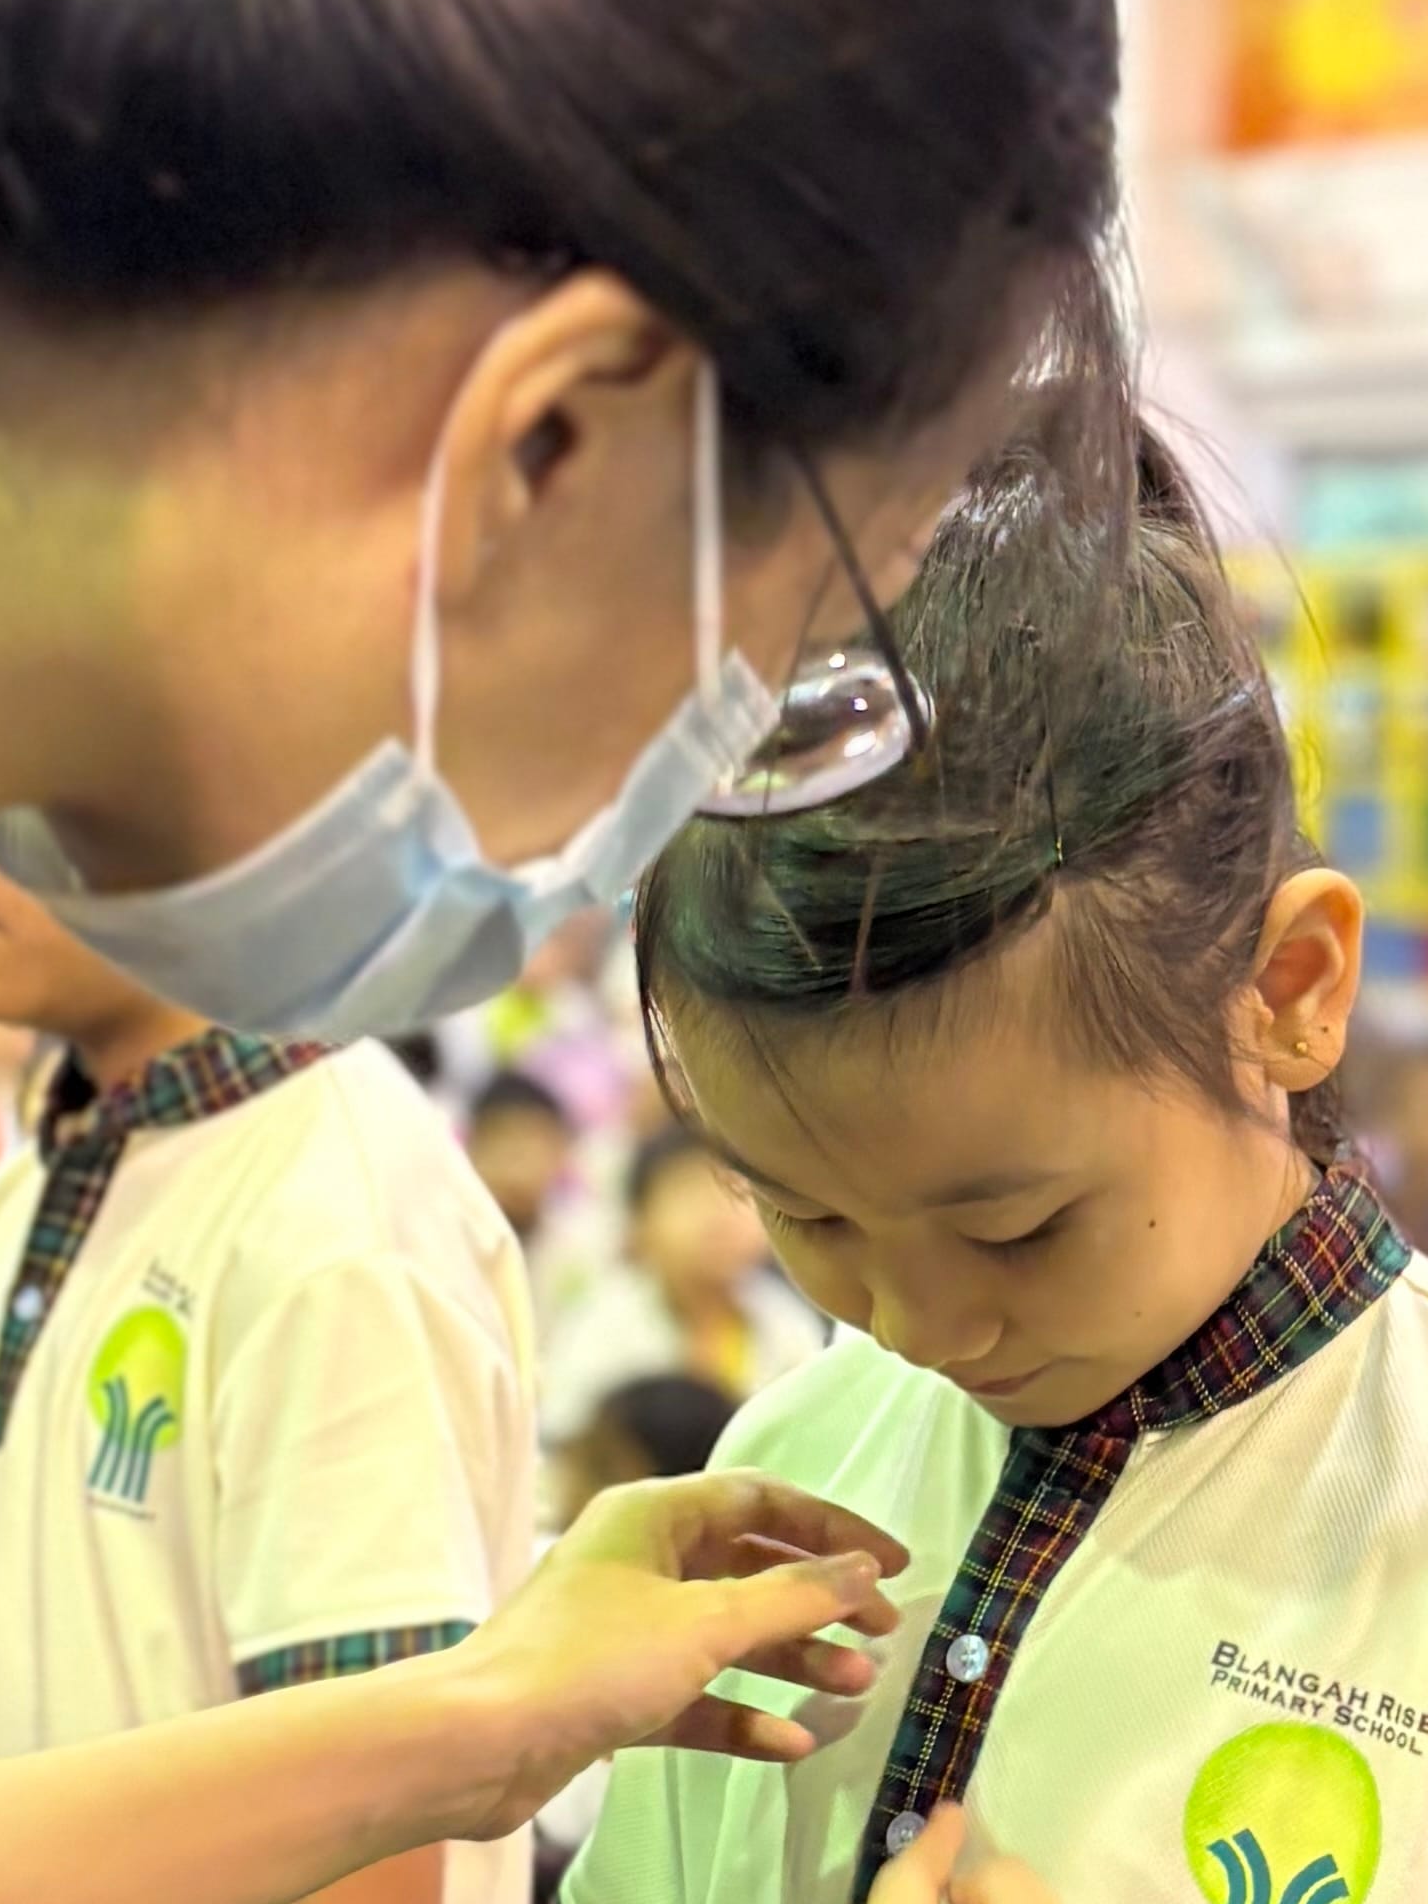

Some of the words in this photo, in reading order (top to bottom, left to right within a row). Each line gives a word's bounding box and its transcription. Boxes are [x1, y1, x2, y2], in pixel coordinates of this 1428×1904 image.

[1210, 1669, 1325, 1718] PRIMARY
[1333, 1705, 1423, 1756] SCHOOL
[1211, 1640, 1368, 1710] BLANGAH
